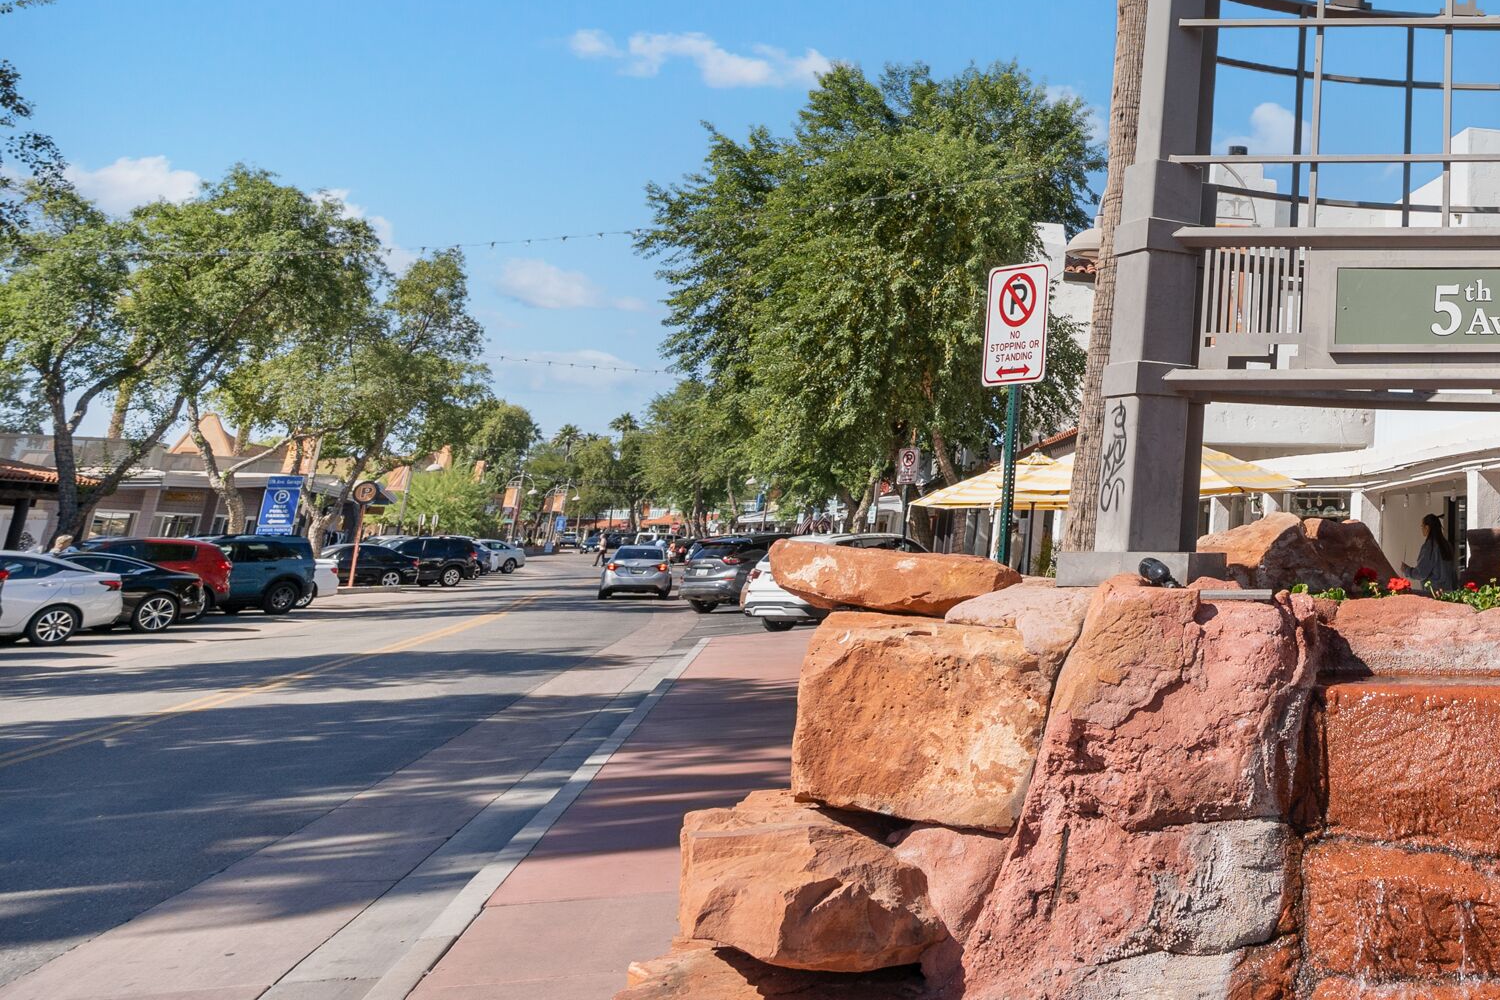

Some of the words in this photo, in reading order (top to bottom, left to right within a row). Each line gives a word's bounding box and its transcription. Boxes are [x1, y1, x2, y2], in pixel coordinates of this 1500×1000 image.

[1430, 279, 1492, 336] 5th
[1010, 330, 1021, 340] NO
[990, 341, 1026, 353] STOPPING
[1029, 339, 1040, 349] OR
[995, 351, 1033, 363] STANDING
